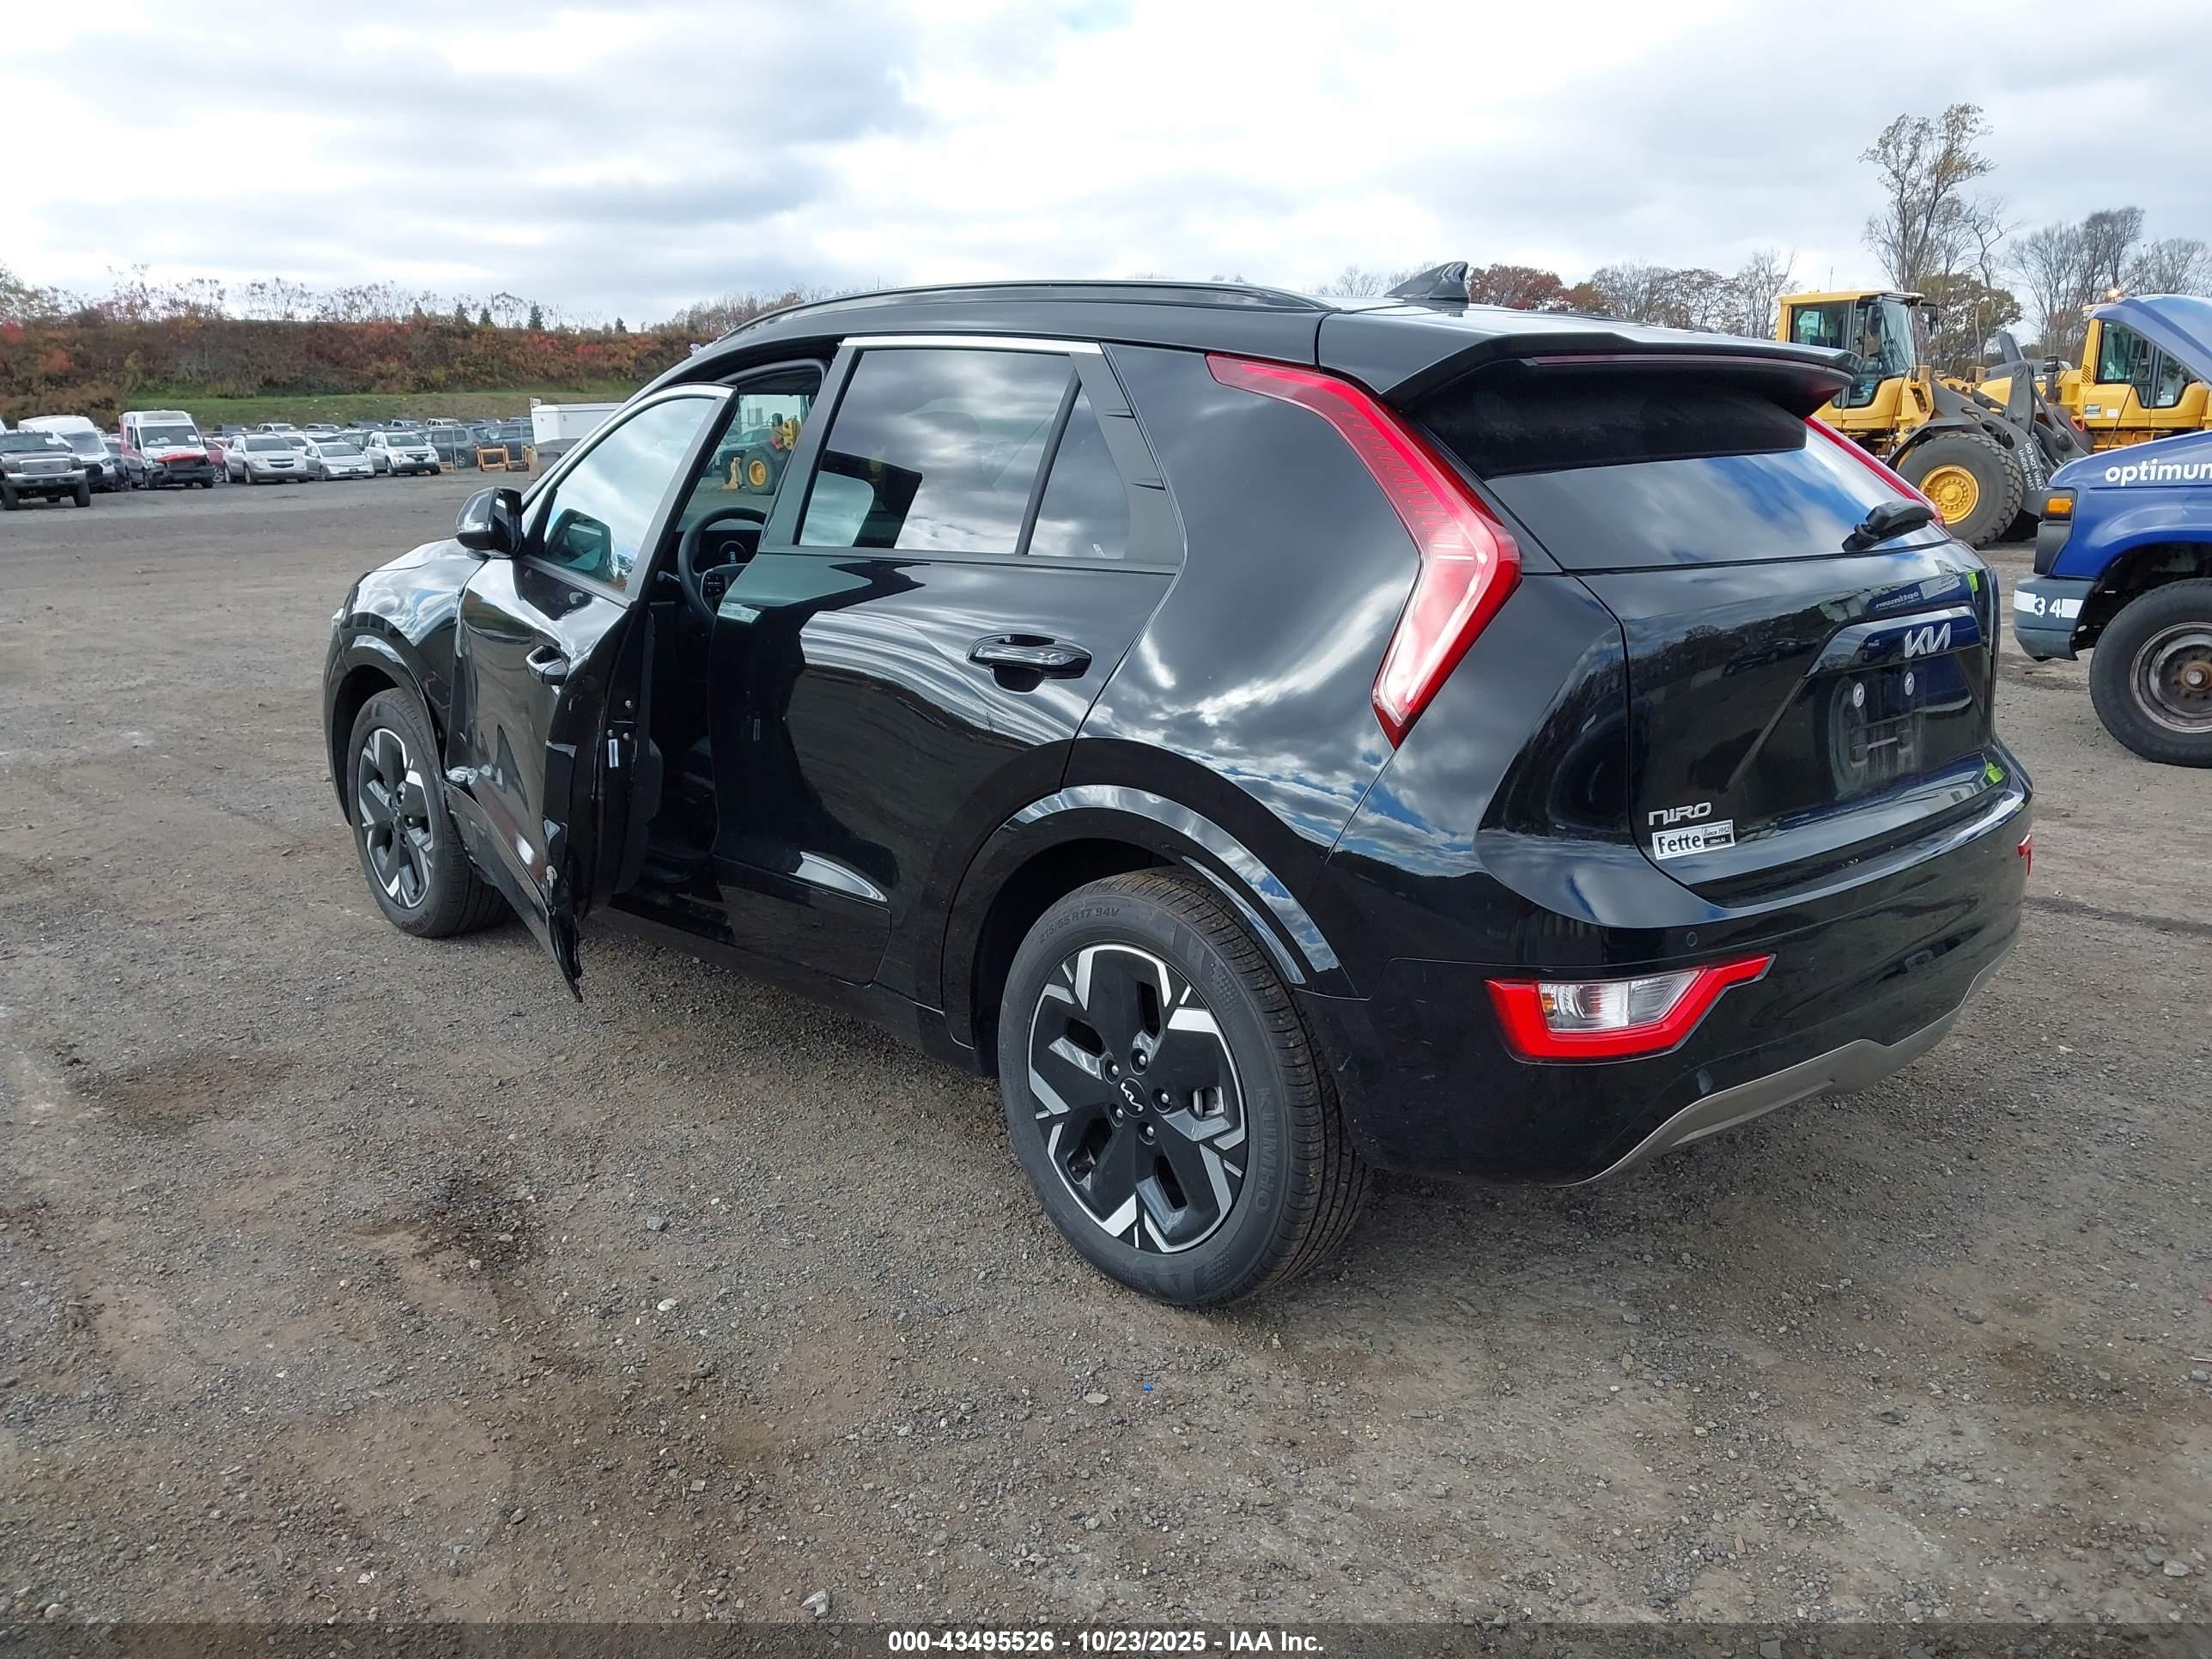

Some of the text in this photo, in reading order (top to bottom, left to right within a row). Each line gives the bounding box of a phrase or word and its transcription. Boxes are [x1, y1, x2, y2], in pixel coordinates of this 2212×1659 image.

[2018, 448, 2036, 491] UNDER MAST
[2025, 442, 2045, 491] DO NOT WALK
[1648, 802, 1712, 826] NIRO
[1656, 833, 1702, 854] Fette
[1255, 1085, 1279, 1214] KUMHO
